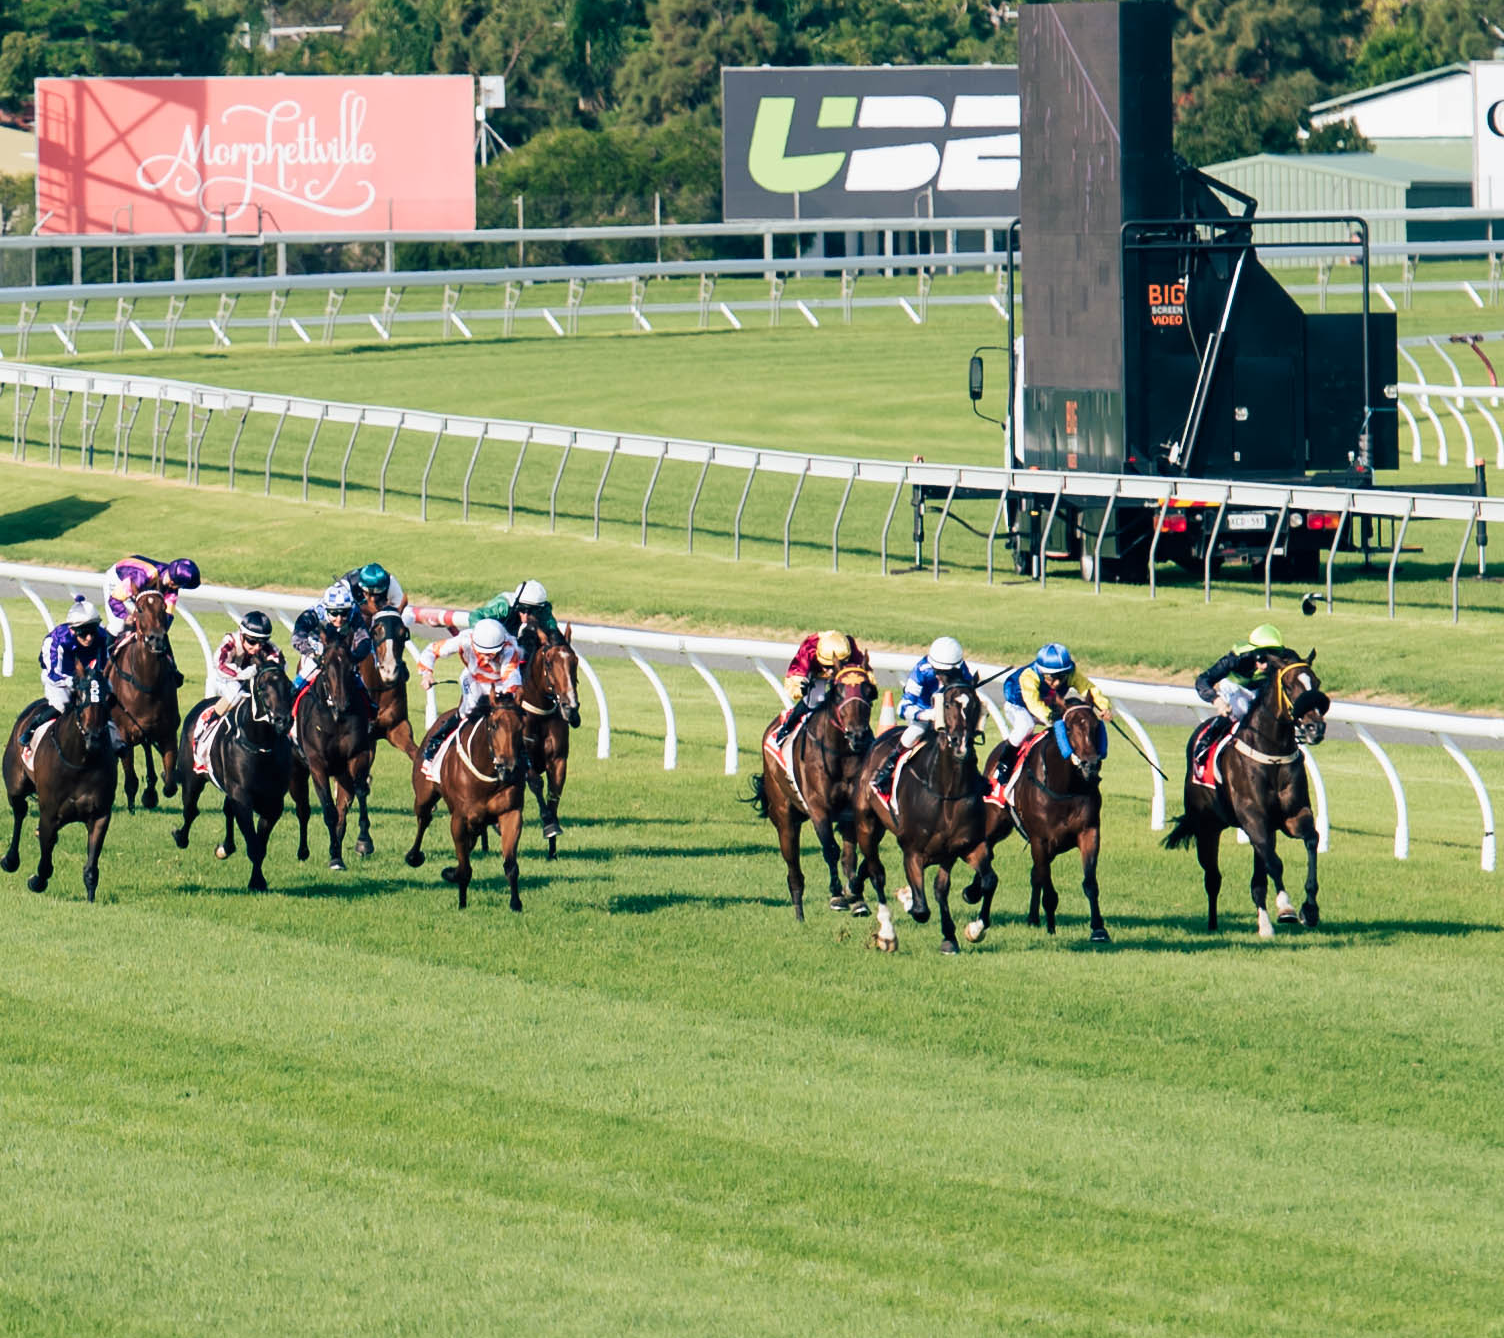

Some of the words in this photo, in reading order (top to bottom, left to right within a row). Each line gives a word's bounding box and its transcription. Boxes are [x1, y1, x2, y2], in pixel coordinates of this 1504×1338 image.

[136, 90, 377, 221] Morphettville
[1148, 284, 1185, 306] BIG
[1151, 306, 1183, 314] SCREEN
[1151, 315, 1183, 326] VIDEO
